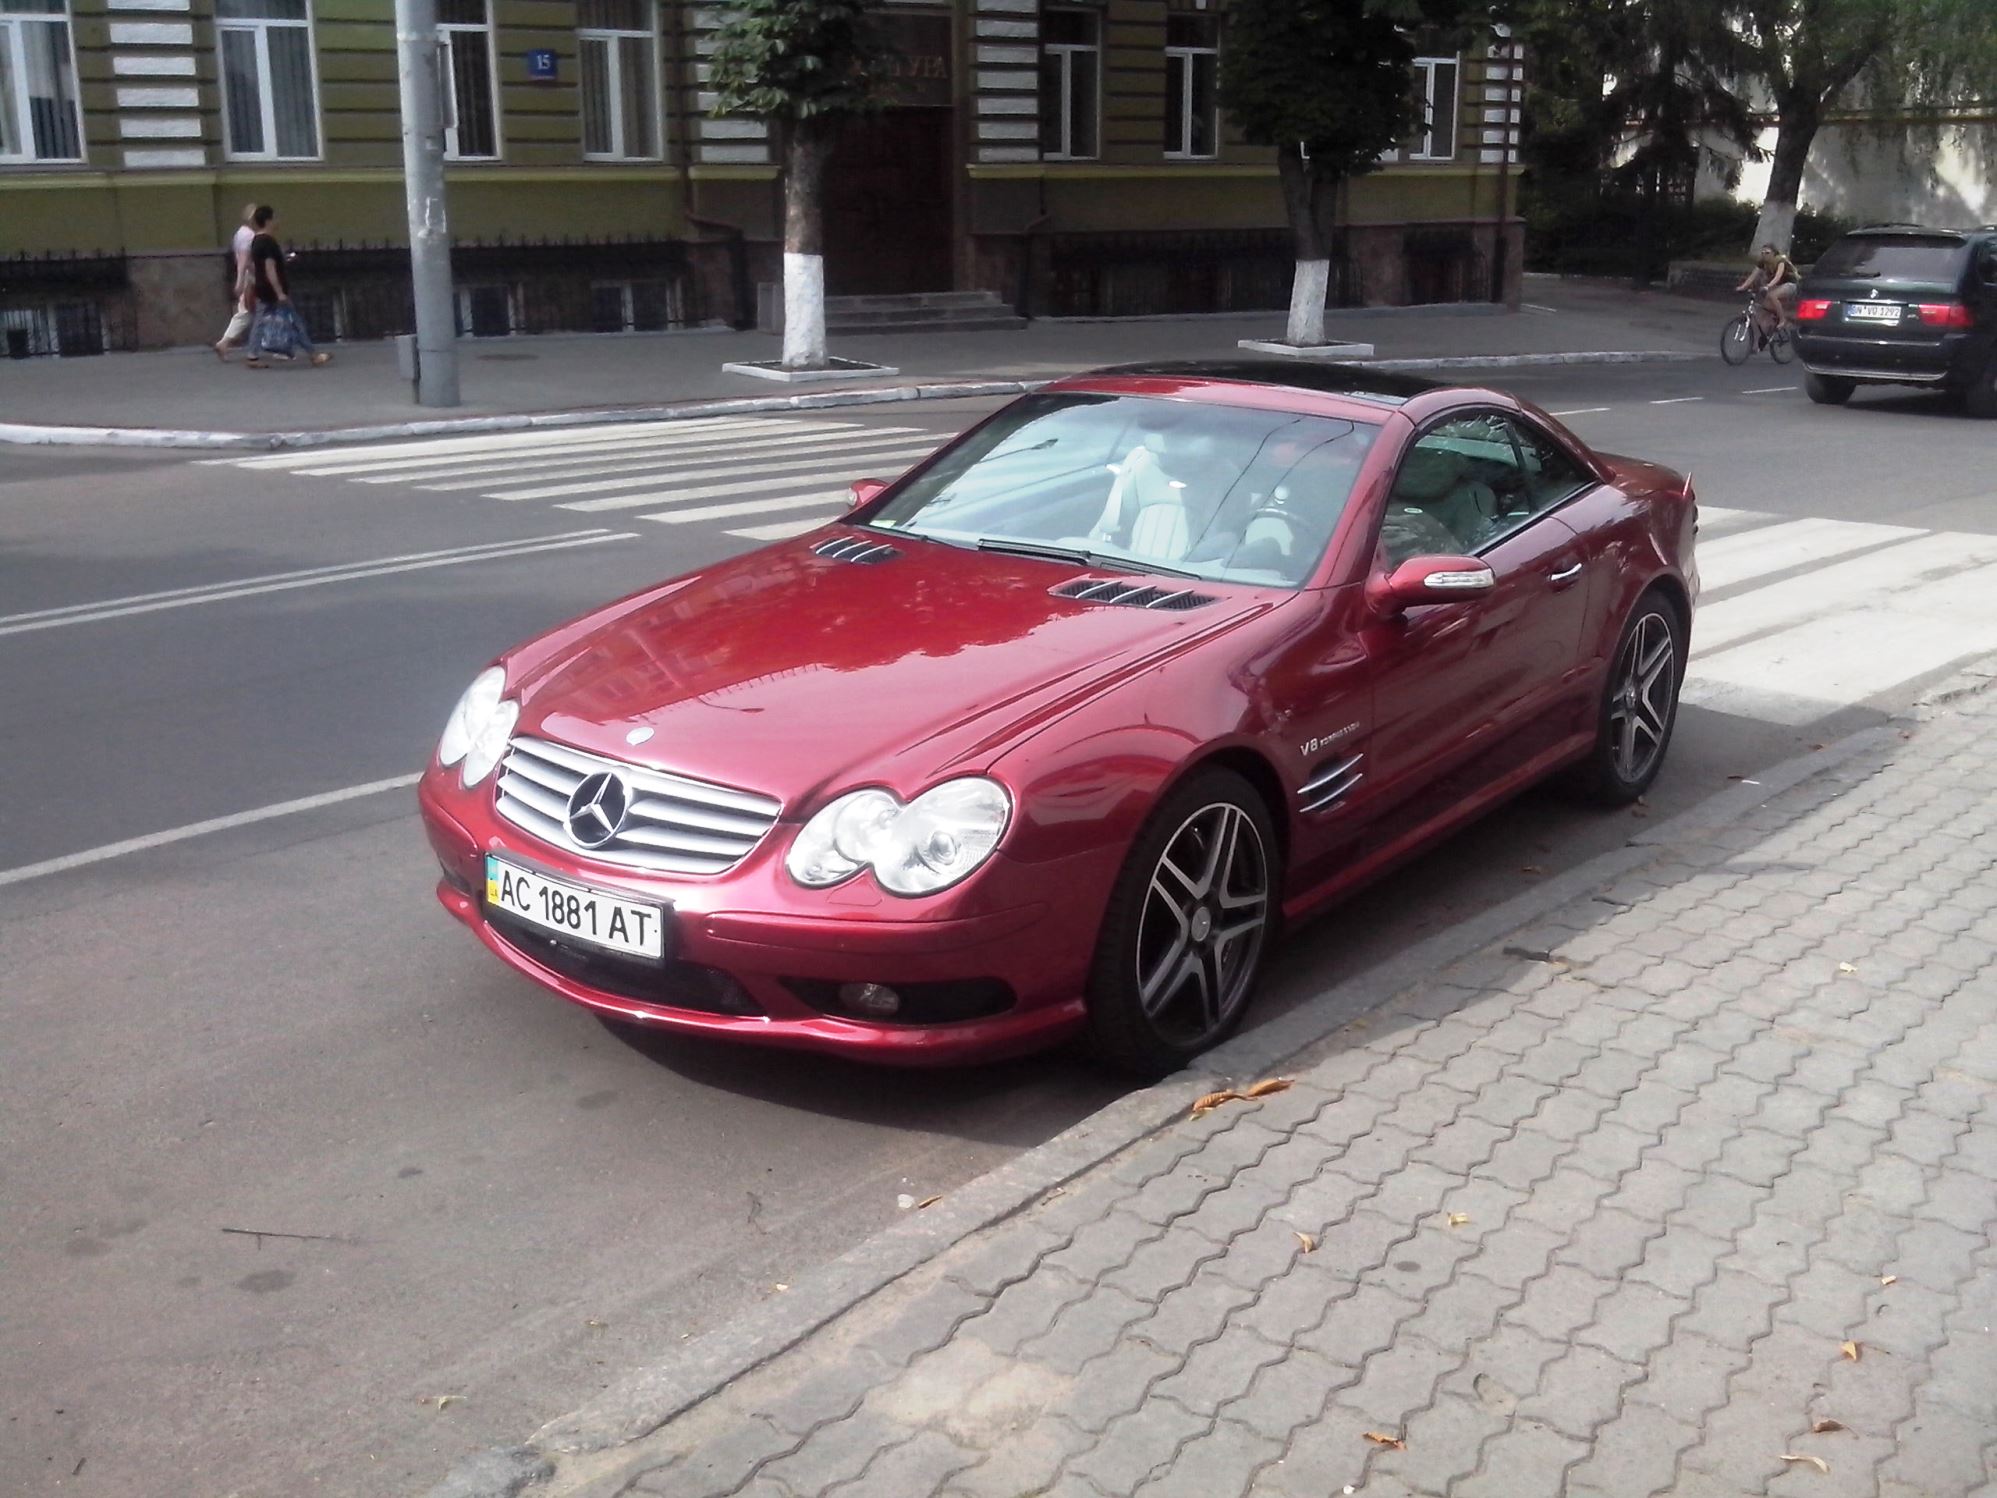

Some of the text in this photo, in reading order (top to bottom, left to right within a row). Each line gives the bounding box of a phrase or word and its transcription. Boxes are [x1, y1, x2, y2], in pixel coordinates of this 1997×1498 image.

[537, 54, 550, 69] 15
[1300, 738, 1318, 755] V8
[501, 870, 652, 946] AC 1881 AT
